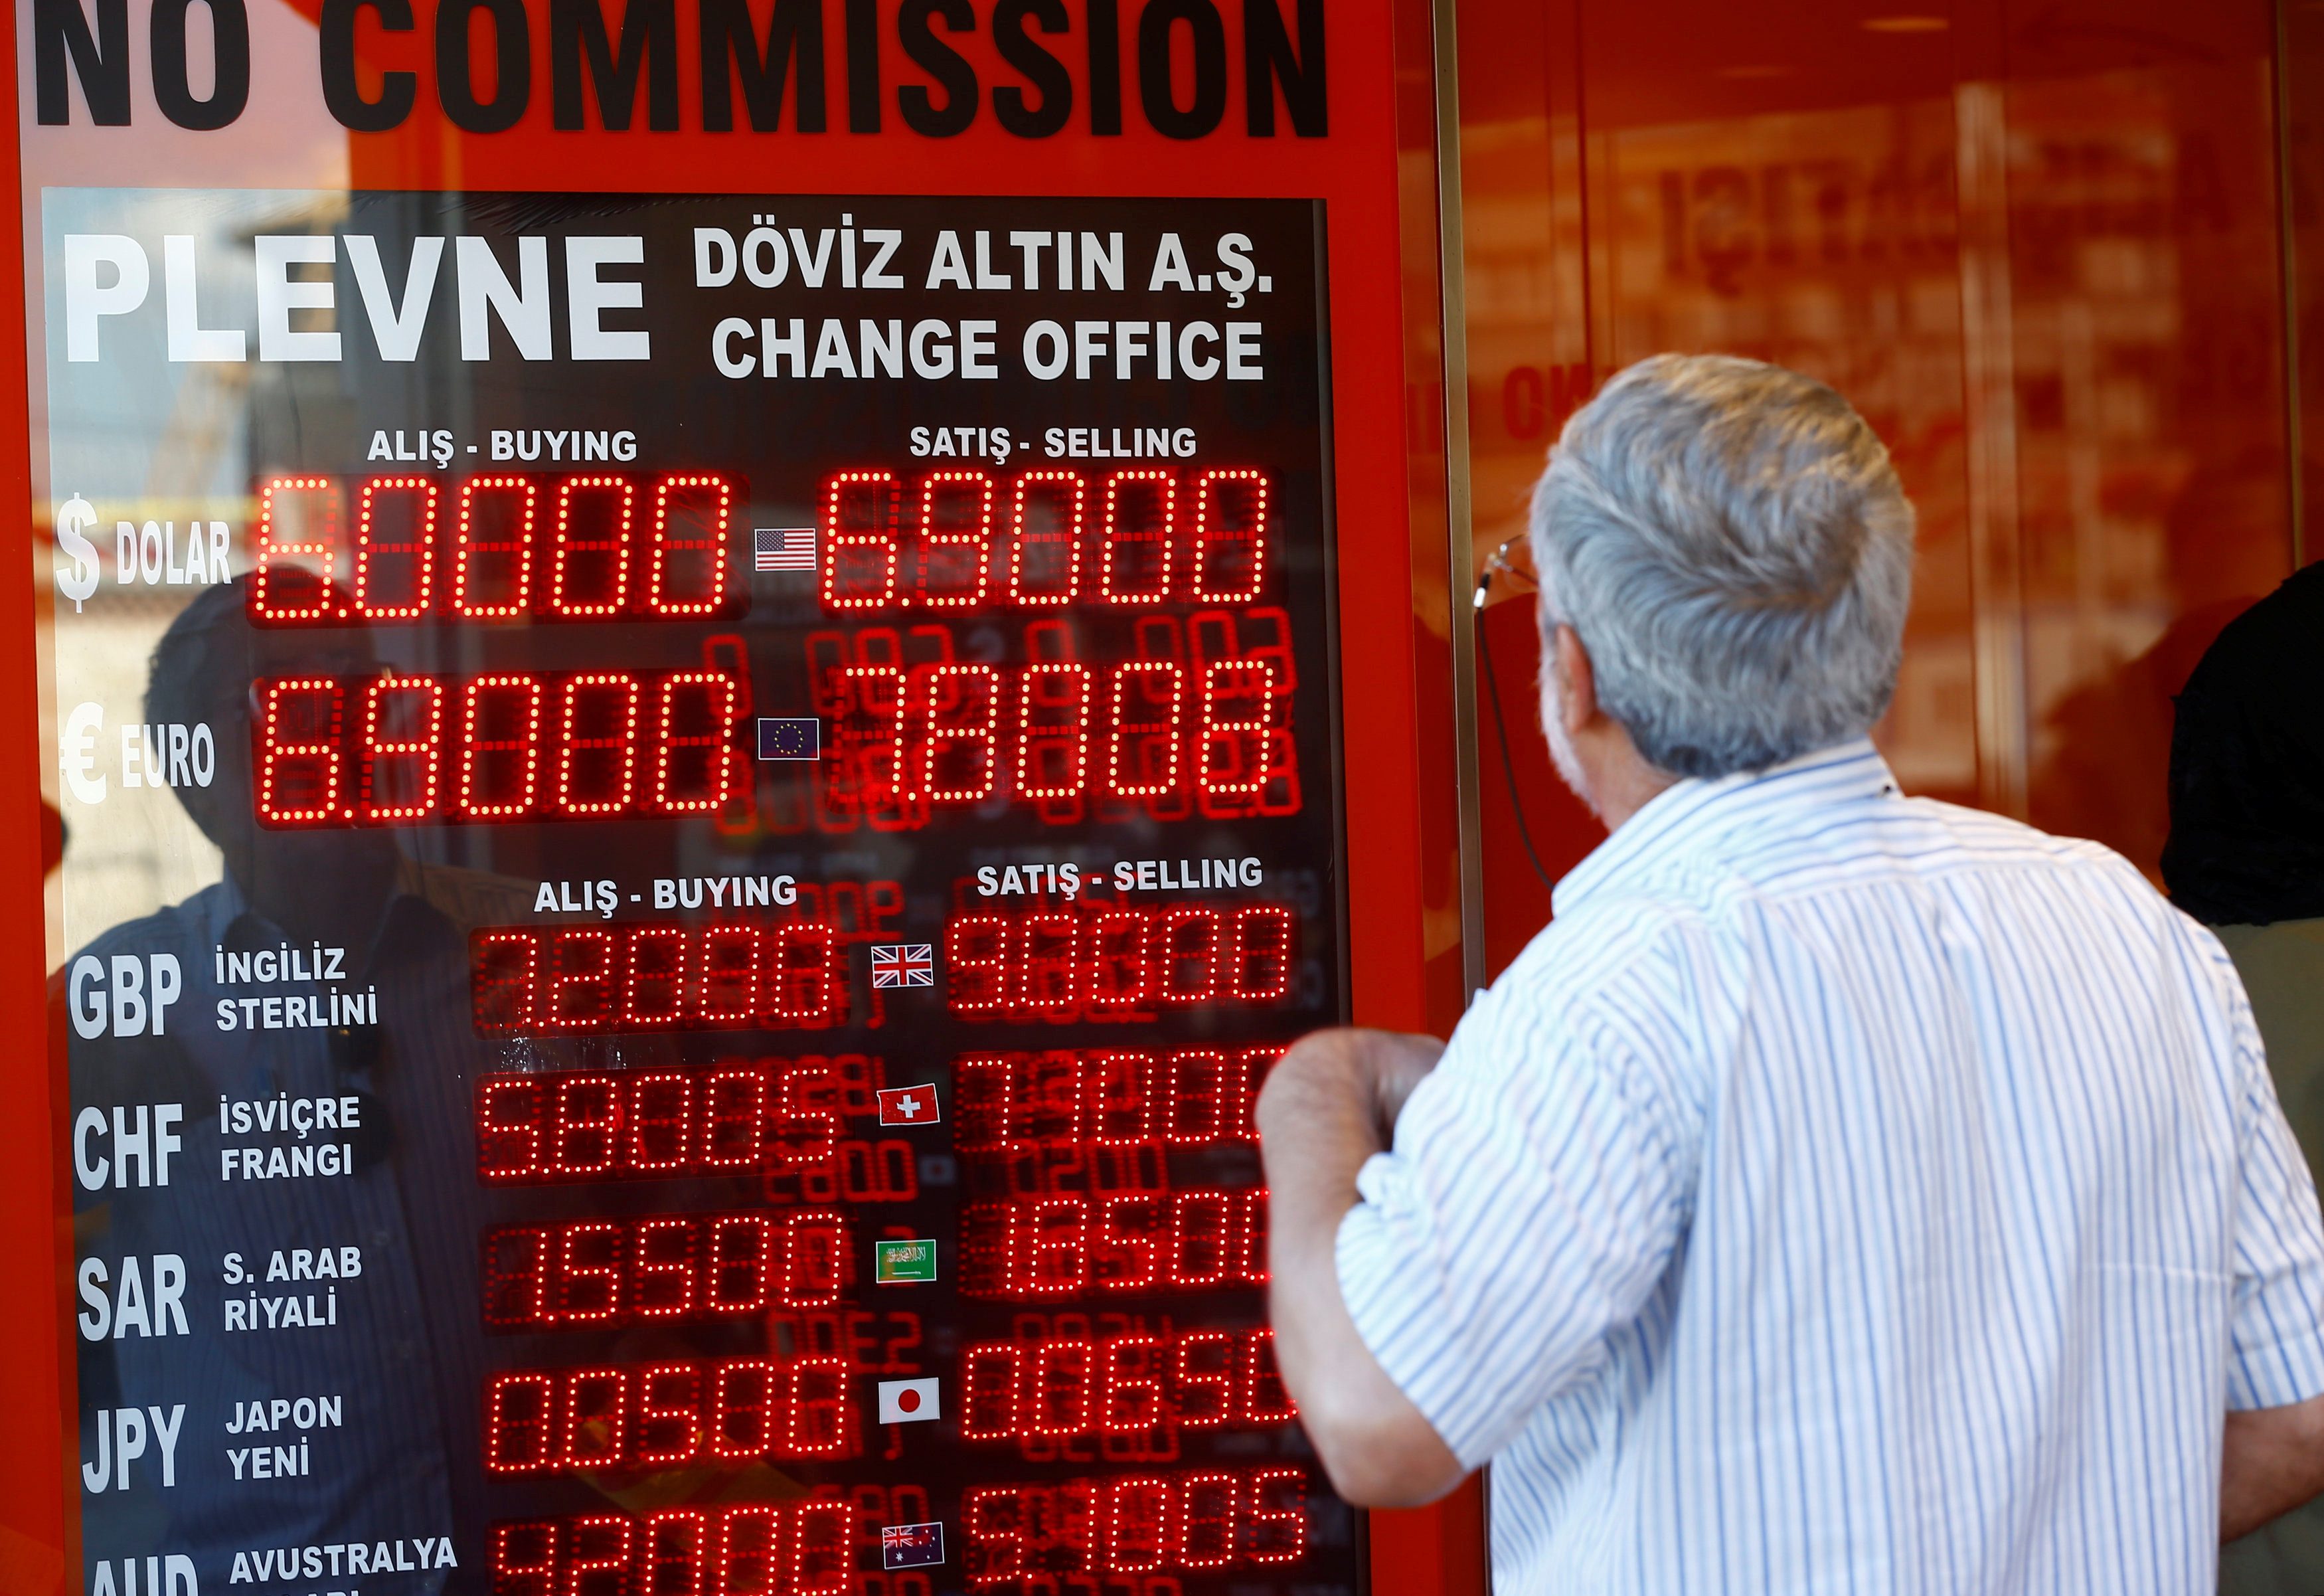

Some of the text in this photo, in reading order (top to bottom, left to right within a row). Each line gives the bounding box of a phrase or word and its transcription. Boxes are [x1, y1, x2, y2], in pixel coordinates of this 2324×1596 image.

[33, 0, 1329, 139] NO COMMISSION
[694, 213, 1272, 309] DÖVİZ ALTIN A.Ş.
[64, 234, 651, 363] PLEVNE
[712, 317, 1264, 381] CHANGE OFFICE
[367, 430, 454, 470] ALIŞ
[491, 430, 637, 462] BUYING
[910, 426, 1011, 465] SATIŞ
[1044, 428, 1196, 458] SELLING
[56, 493, 232, 614] $ DOLAR
[823, 470, 1269, 609] 6.9000
[60, 702, 216, 804] € EURO
[260, 672, 736, 822] 6.9000
[534, 880, 618, 919] ALIŞ
[653, 875, 797, 909] BUYING
[977, 863, 1080, 901] SATIŞ
[1114, 857, 1262, 891] SELLING
[216, 940, 346, 984] İNGİLİZ
[69, 953, 183, 1040] GBP
[216, 985, 377, 1031] STERLİNİ
[220, 1091, 361, 1139] İSVİÇRE
[74, 1103, 183, 1191] CHF
[221, 1144, 352, 1181] FRANGI
[223, 1247, 362, 1285] S. ARAB
[78, 1254, 190, 1341] SAR
[224, 1281, 336, 1331] RİYALİ
[225, 1395, 342, 1434] JAPON
[82, 1404, 186, 1493] JPY
[226, 1436, 309, 1480] YENİ
[229, 1537, 458, 1584] AVUSTRALYA
